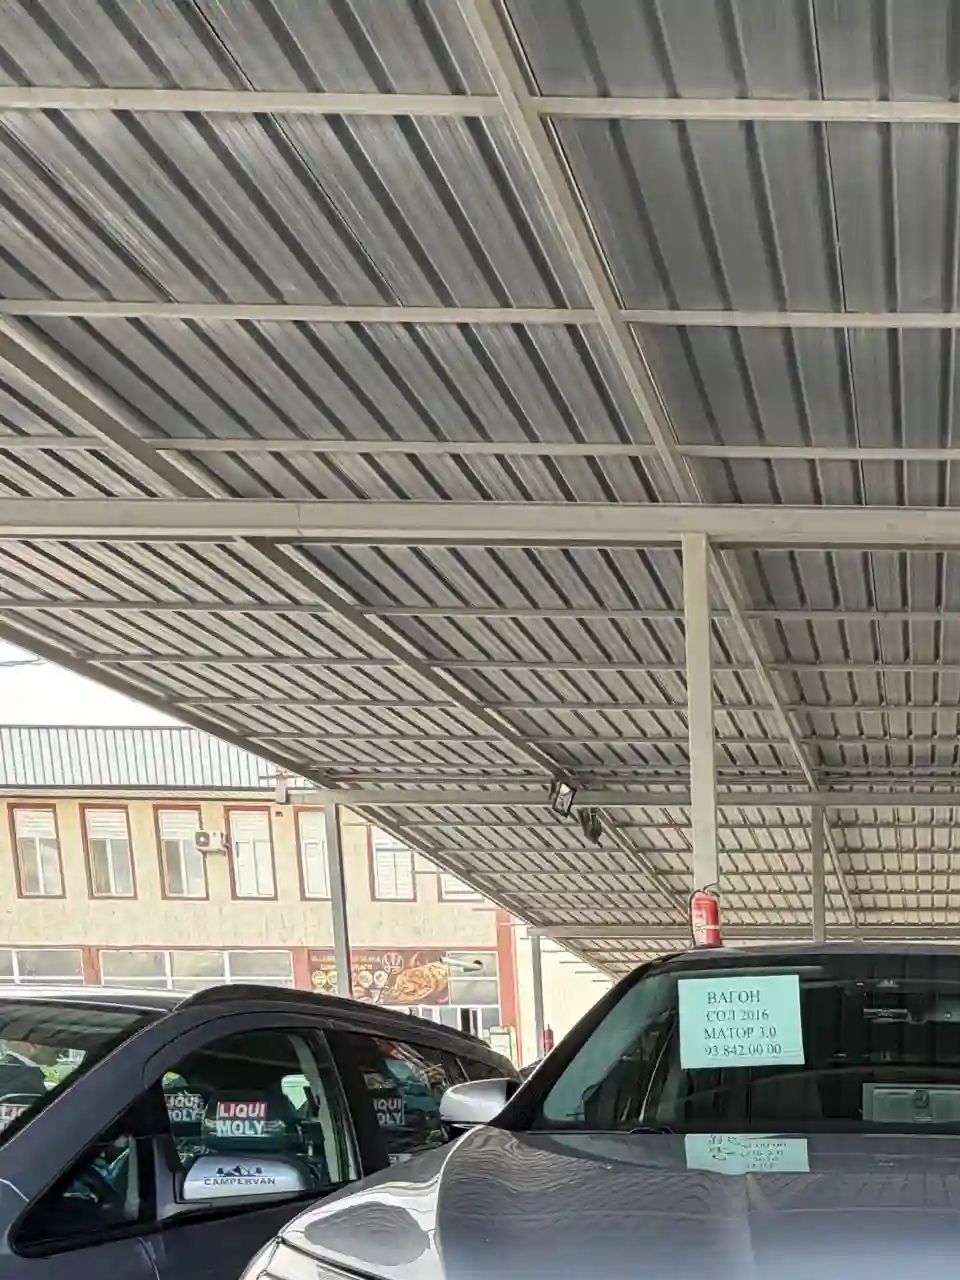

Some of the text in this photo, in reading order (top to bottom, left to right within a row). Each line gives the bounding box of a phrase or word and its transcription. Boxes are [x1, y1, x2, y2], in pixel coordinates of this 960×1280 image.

[708, 989, 761, 1004] ВАГОН
[740, 1009, 769, 1021] 2016
[704, 1026, 777, 1040] МАТОР 3.0
[220, 1102, 265, 1117] LIQUI
[376, 1112, 401, 1124] OLY
[217, 1120, 265, 1134] MOLY
[204, 1178, 275, 1186] CAMPERVAN
